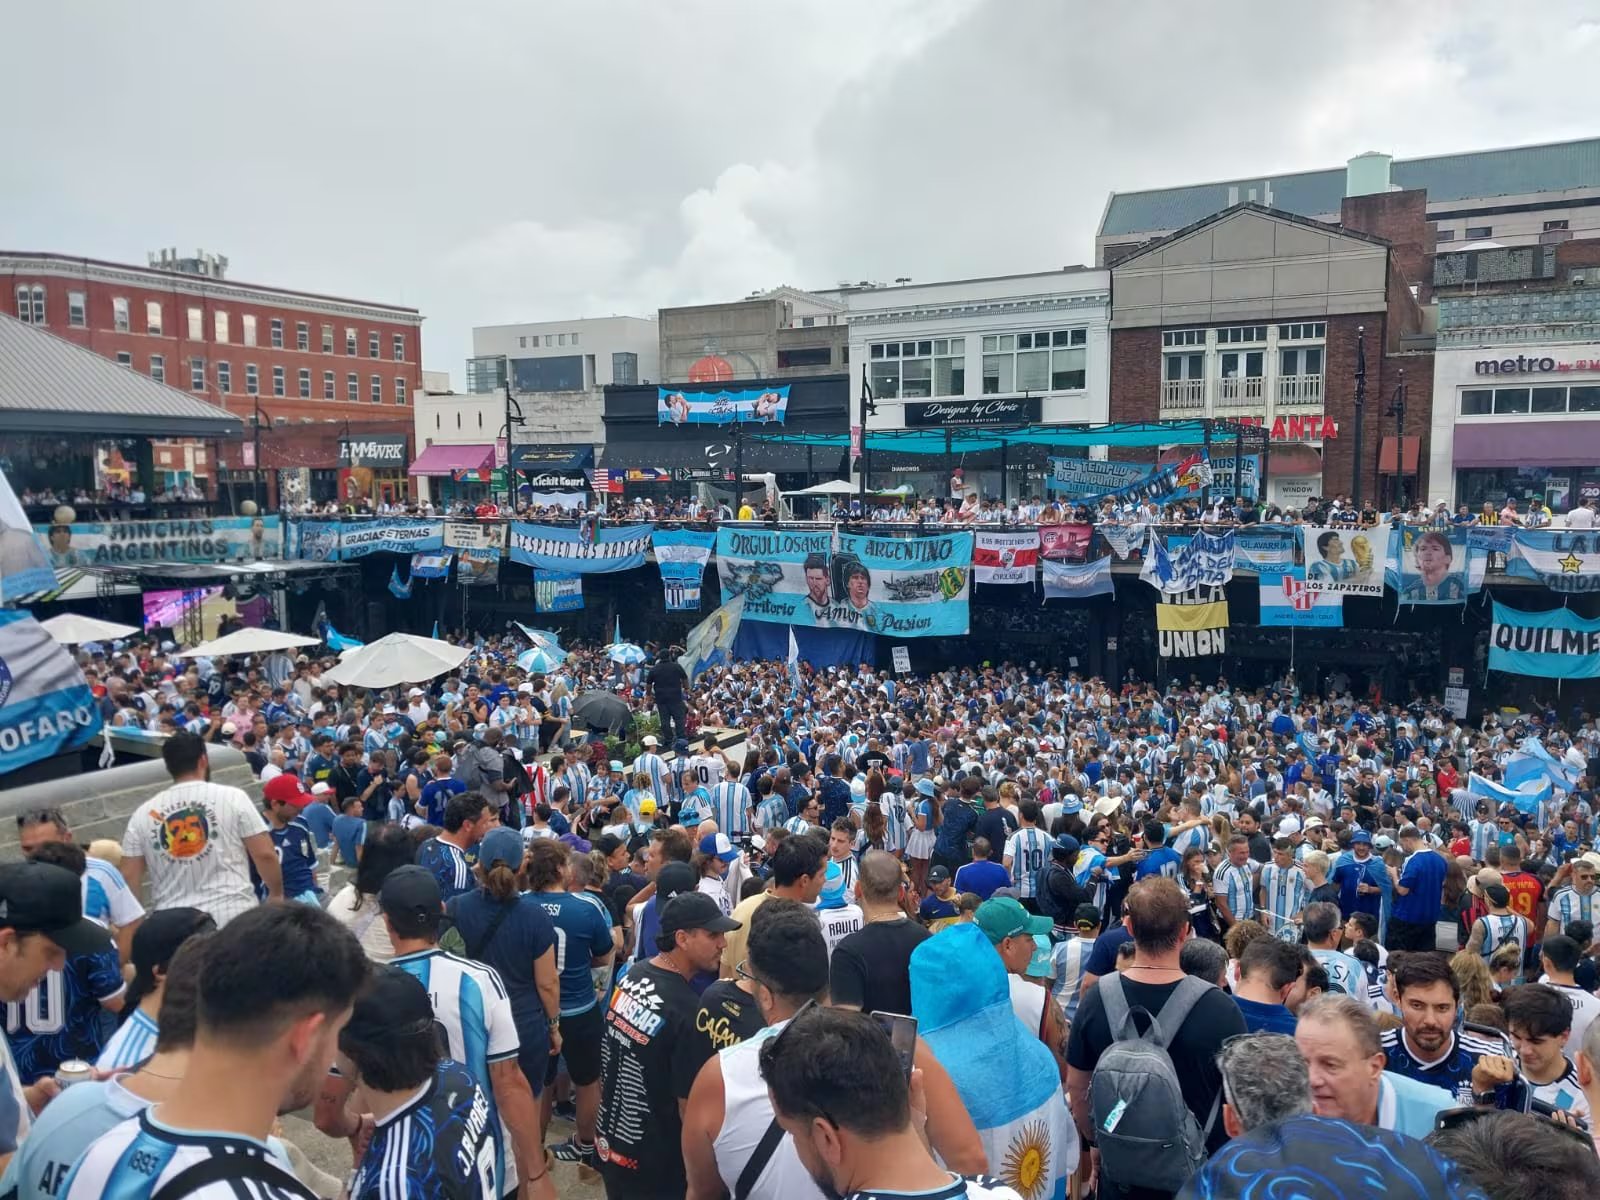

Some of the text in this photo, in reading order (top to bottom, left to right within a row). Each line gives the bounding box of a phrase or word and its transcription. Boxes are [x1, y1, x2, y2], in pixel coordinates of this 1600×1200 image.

[1475, 354, 1555, 374] metro
[923, 399, 1019, 418] Designs by Chris
[1057, 471, 1071, 482] DE
[1074, 473, 1087, 484] LA
[1063, 460, 1127, 477] EL TEMPLO
[532, 475, 559, 487] Kickit
[1581, 487, 1600, 497] $20
[345, 527, 430, 545] GRACIAS ETERNAS
[94, 539, 229, 561] ARGENTINOS
[575, 543, 598, 560] LOS
[865, 539, 954, 563] ARGENTINO
[1307, 572, 1320, 580] DE
[1306, 582, 1382, 593] LOS ZAPATEROS
[742, 598, 797, 616] erritorio
[1158, 627, 1226, 658] UNION
[1023, 848, 1043, 873] 10
[539, 903, 562, 917] ESSI
[1319, 962, 1351, 983] SSI
[613, 990, 661, 1037] NASCAR
[613, 1016, 650, 1046] SERIES
[37, 1160, 72, 1197] AF
